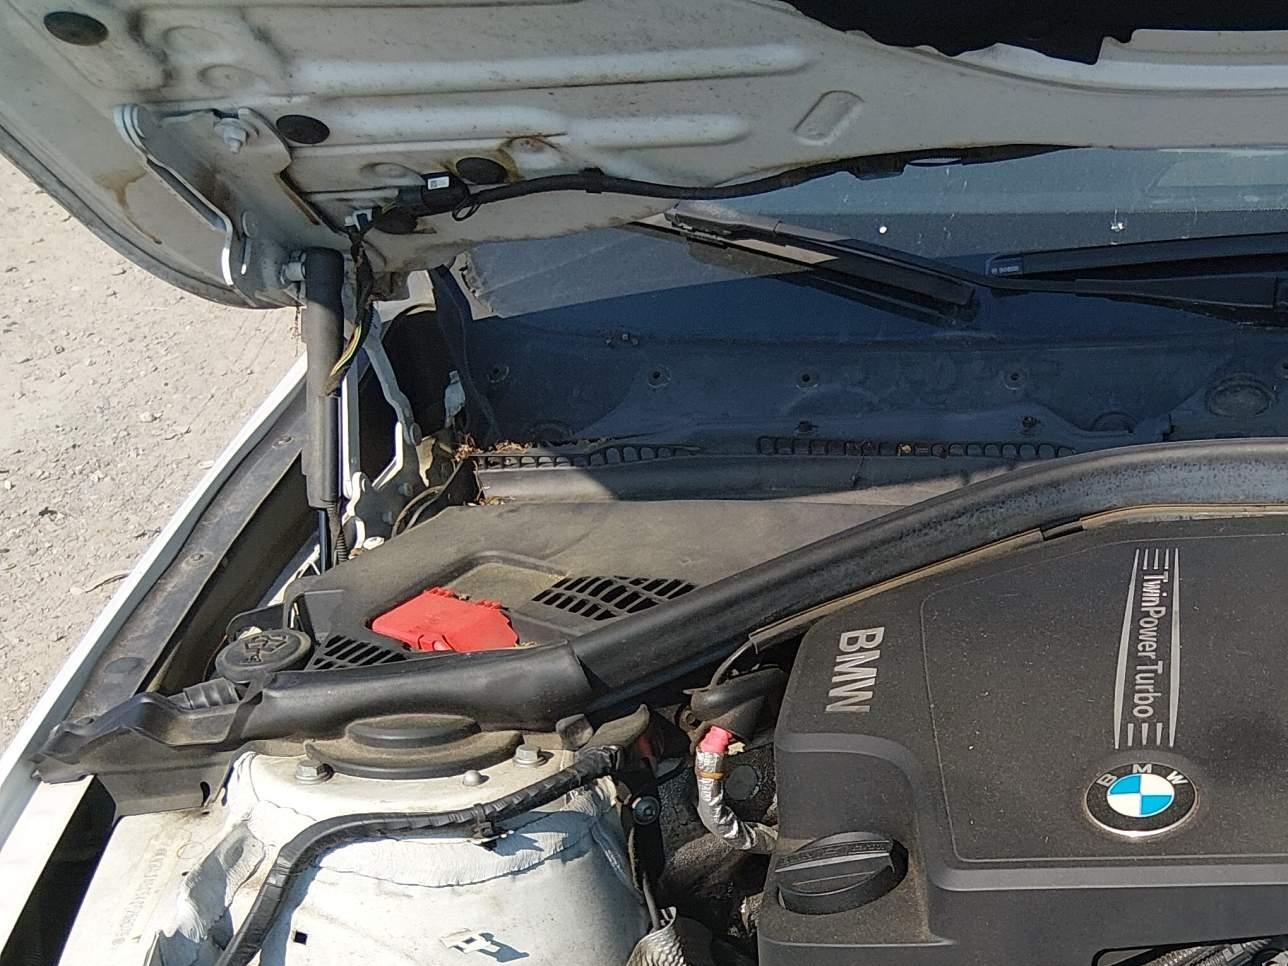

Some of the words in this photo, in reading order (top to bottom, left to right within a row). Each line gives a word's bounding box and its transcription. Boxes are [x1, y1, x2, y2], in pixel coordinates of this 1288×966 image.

[1137, 571, 1168, 659] TwinPower
[825, 627, 885, 713] BMW
[1132, 661, 1163, 718] Turbo
[1096, 763, 1188, 787] BMW
